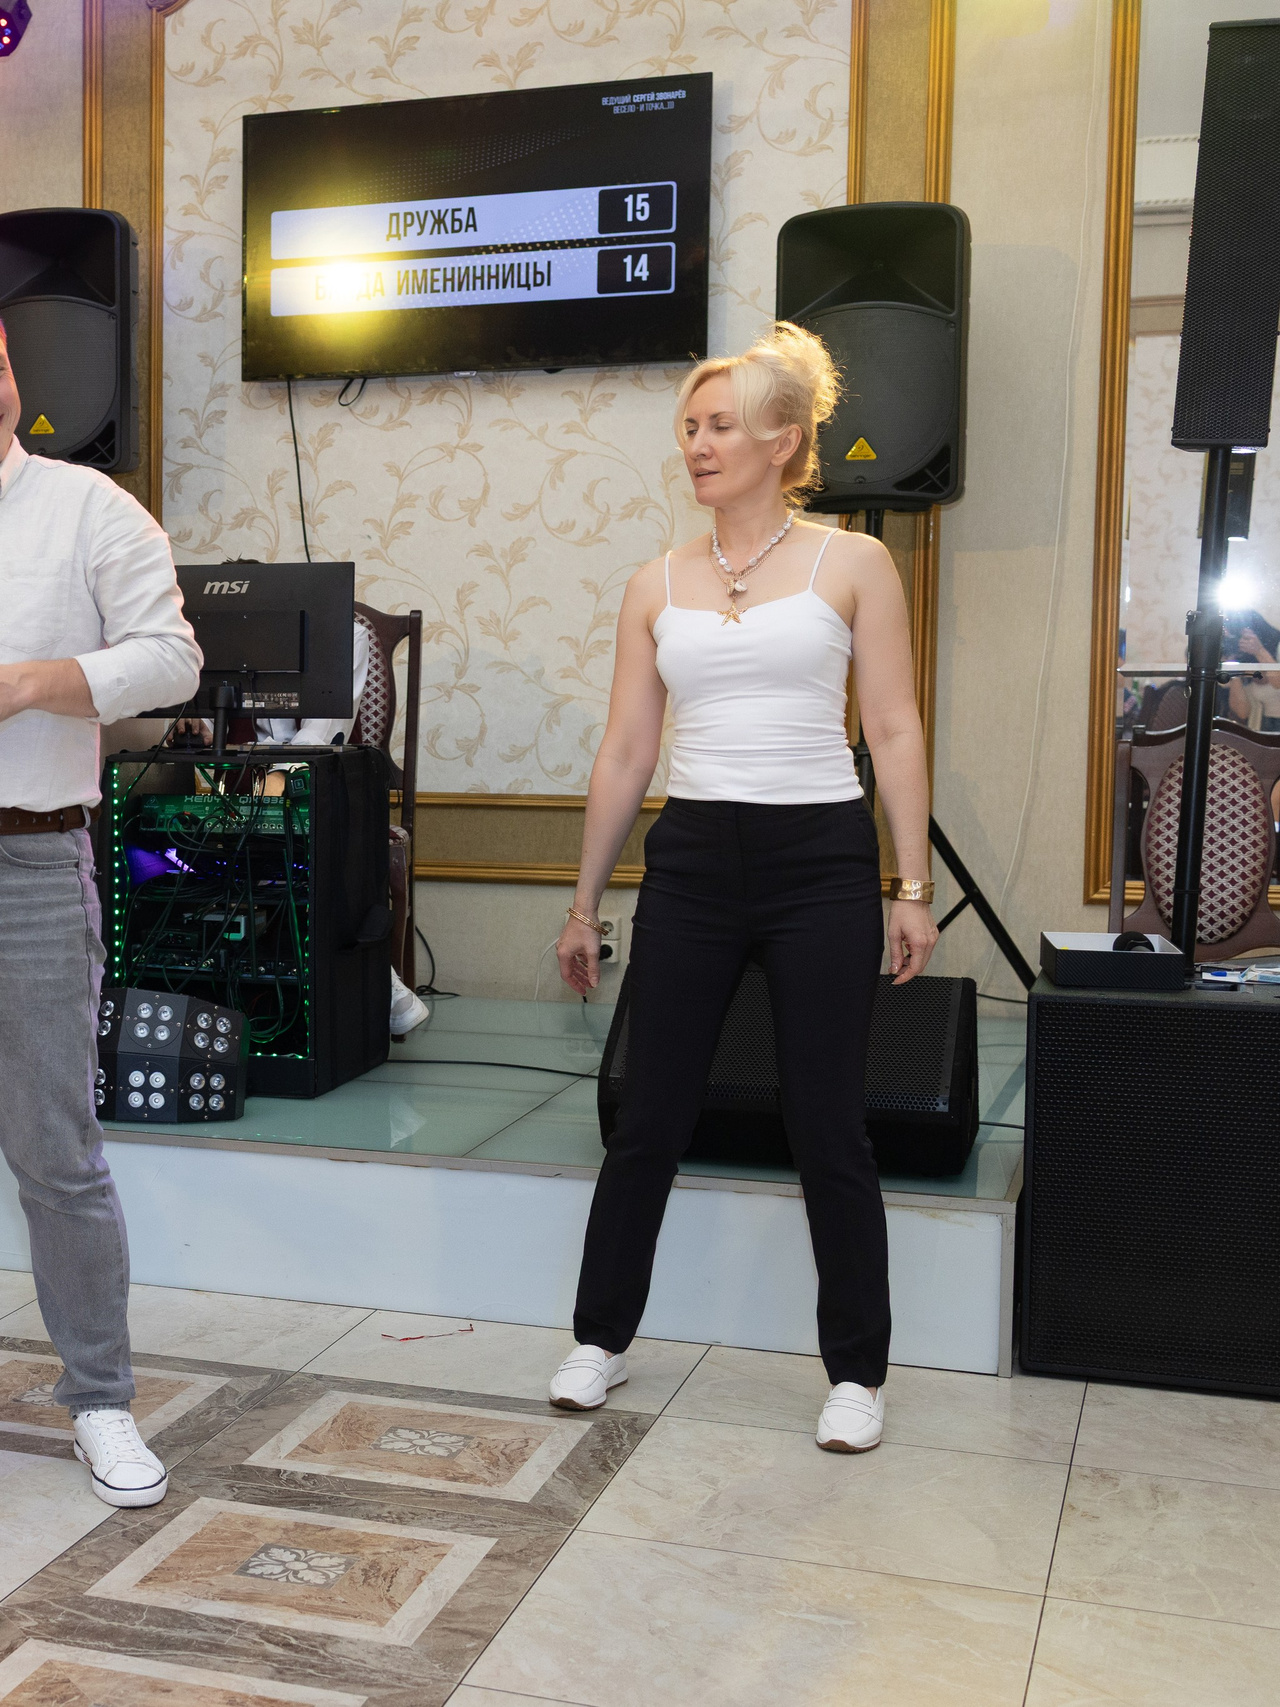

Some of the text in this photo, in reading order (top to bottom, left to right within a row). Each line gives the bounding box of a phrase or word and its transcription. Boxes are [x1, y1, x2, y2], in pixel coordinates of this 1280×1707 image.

[602, 89, 687, 106] ВЕДУЩИЙ СЕРГЕЙ ЗВОНАРЁВ
[613, 104, 636, 114] ВЕСЕЛО
[385, 193, 650, 242] ДРУЖБА 15
[314, 254, 649, 301] БДА ИМЕНИННИЦЫ 14
[203, 580, 251, 595] msi
[184, 795, 228, 803] XENY
